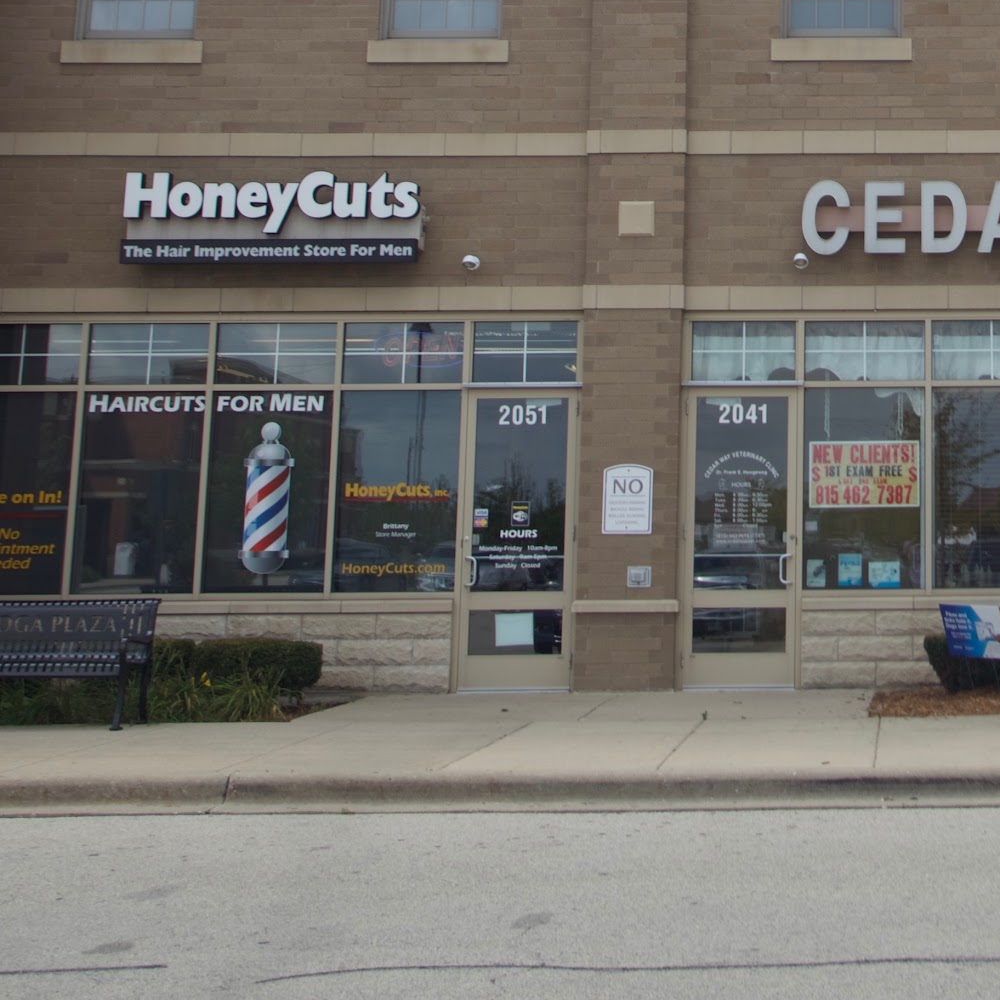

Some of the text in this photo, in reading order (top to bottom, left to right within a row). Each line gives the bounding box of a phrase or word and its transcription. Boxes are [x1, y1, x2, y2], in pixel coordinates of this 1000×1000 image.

[123, 171, 420, 234] HoneyCuts
[123, 244, 413, 261] The Hair Improvement Store For Men
[88, 393, 325, 413] HAIRCUTS FOR MEN
[499, 405, 547, 425] 2051
[719, 403, 767, 424] 2041
[813, 444, 915, 464] NEW CLIENTS!
[824, 466, 841, 477] 1ST
[846, 465, 873, 477] EXAM
[879, 465, 903, 477] FREE
[613, 479, 644, 494] NO
[815, 485, 913, 505] 815 462 7387
[11, 493, 34, 504] on
[38, 490, 63, 504] In!
[500, 529, 538, 538] HOURS
[341, 562, 446, 577] HoneyCuts.com
[51, 615, 117, 633] PLAZA
